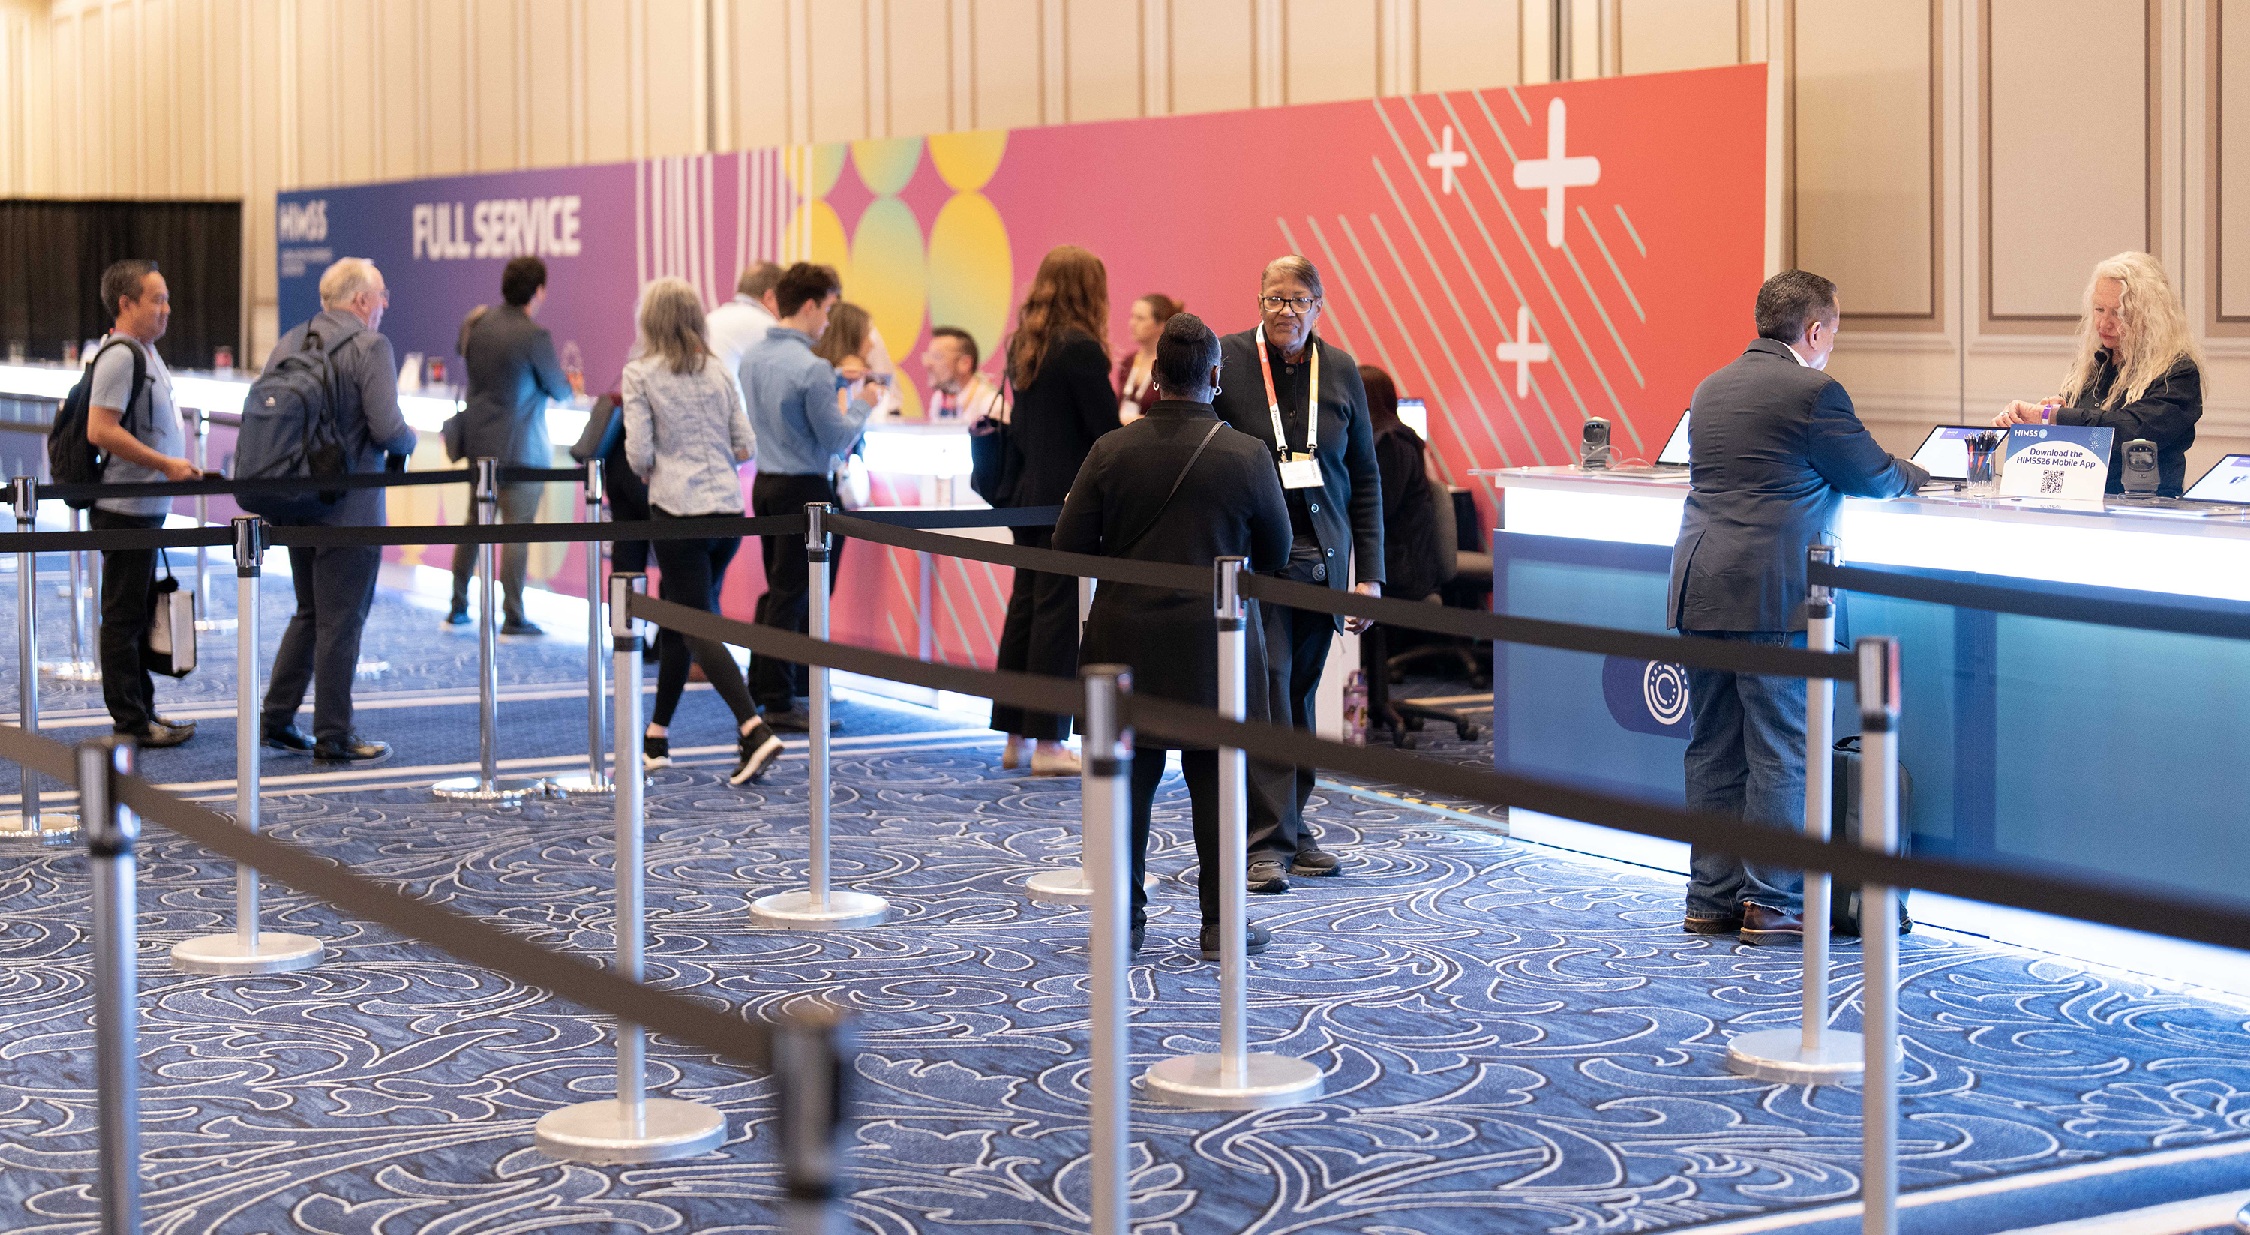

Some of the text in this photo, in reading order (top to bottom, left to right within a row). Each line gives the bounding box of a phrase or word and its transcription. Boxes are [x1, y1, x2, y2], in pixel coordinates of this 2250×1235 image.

[412, 196, 581, 260] FULL SERVICE
[2014, 429, 2039, 437] HIMSS
[2029, 447, 2083, 458] Download the
[2016, 456, 2096, 469] HIMSS26 Mobile App
